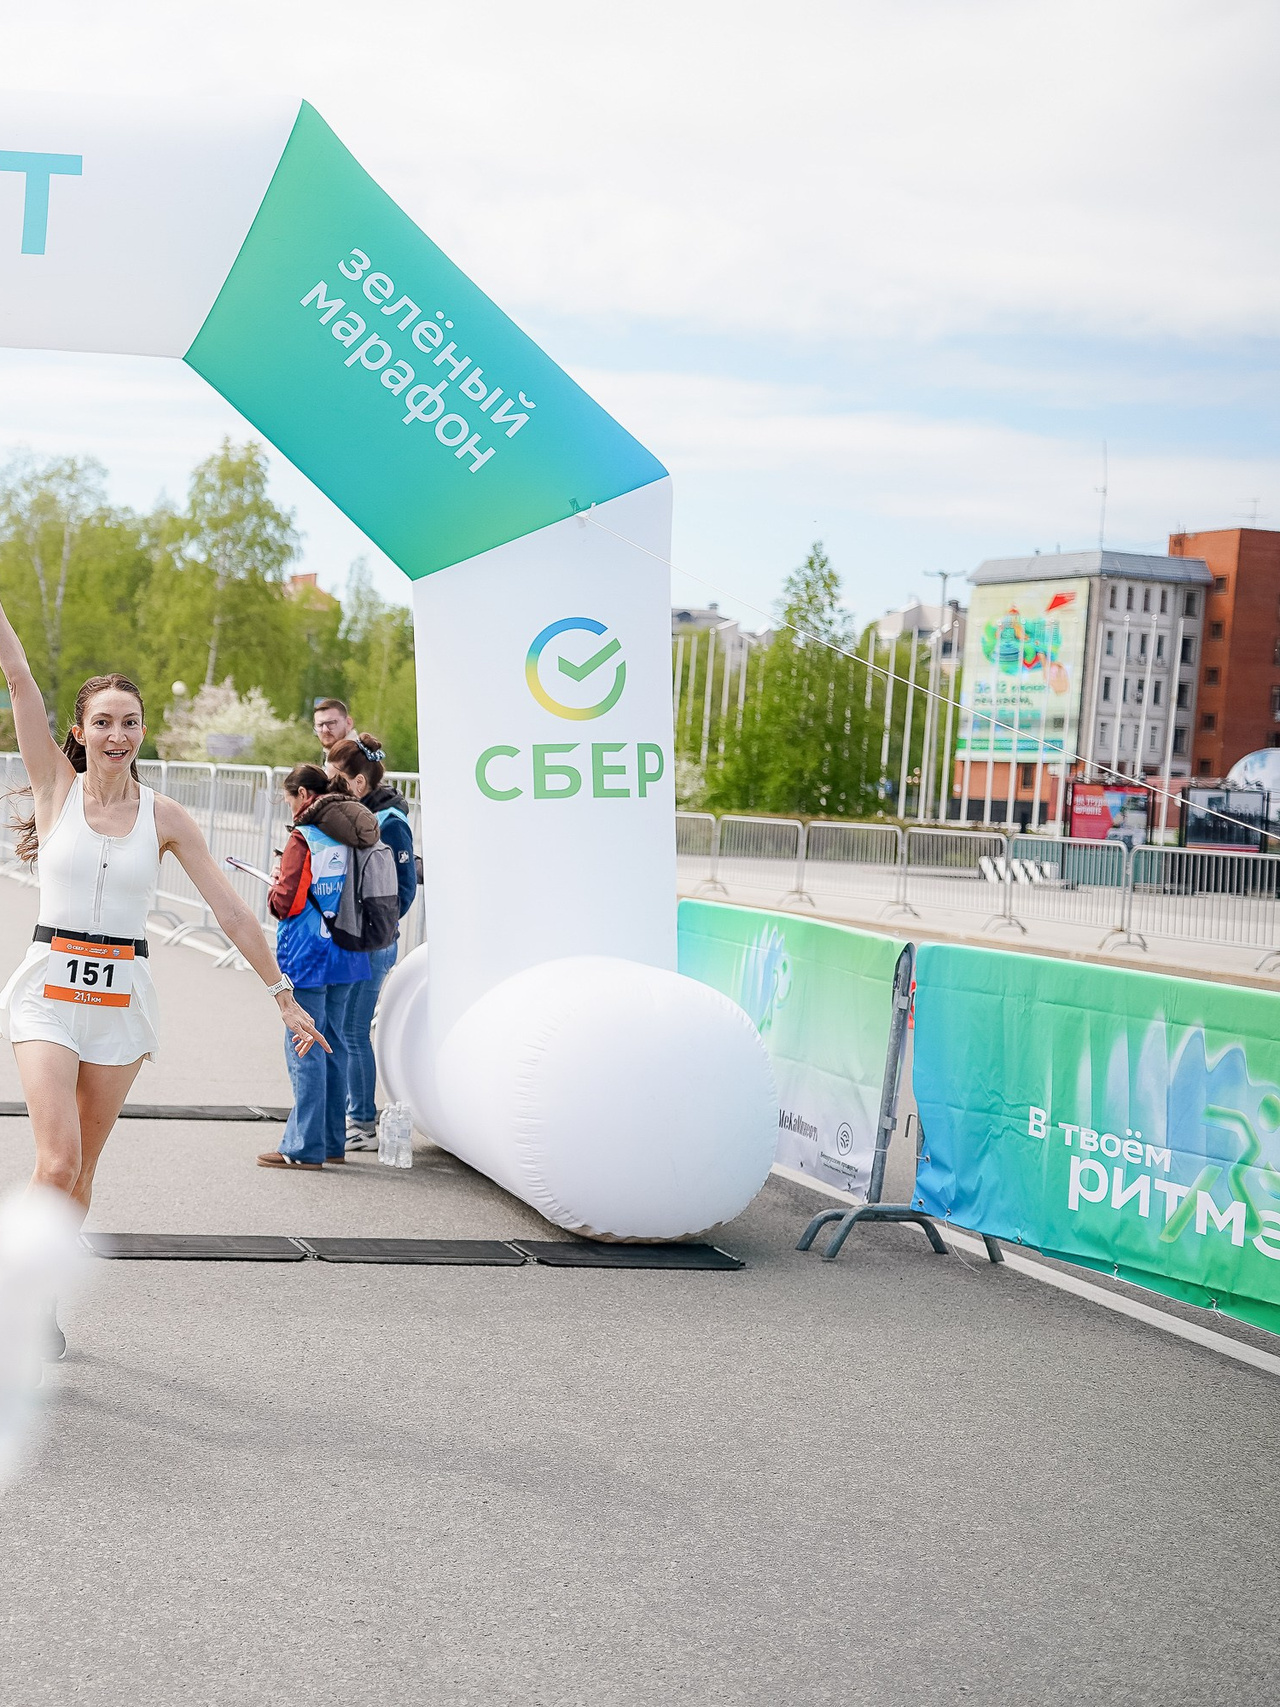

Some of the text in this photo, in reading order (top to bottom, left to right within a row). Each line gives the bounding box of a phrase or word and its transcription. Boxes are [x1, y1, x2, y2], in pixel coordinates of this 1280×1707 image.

[299, 279, 497, 474] марафон
[337, 247, 537, 439] зелёный
[475, 742, 665, 801] СБЕР
[66, 959, 115, 988] 151
[1027, 1105, 1173, 1173] В твоём
